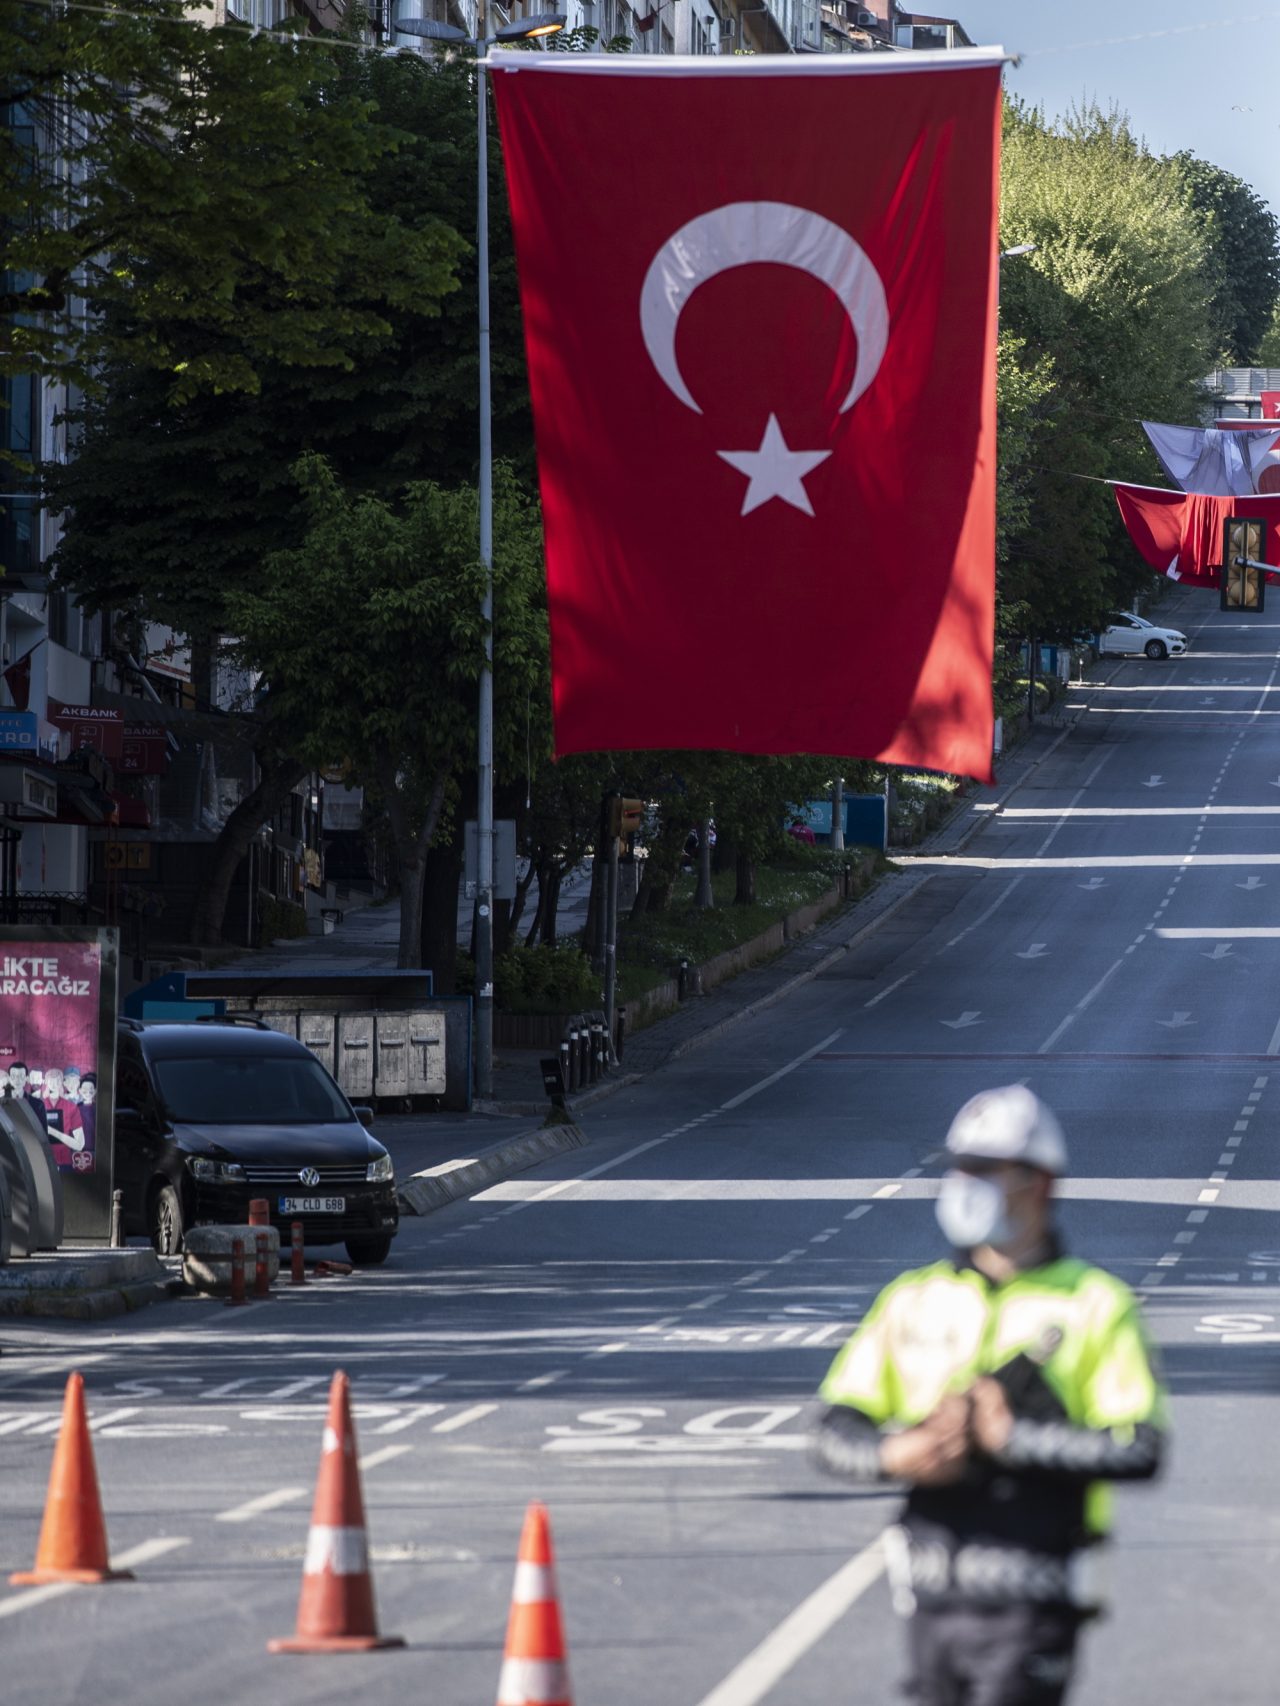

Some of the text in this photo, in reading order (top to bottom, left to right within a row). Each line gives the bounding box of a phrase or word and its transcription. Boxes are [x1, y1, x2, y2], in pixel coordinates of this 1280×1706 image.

[61, 707, 118, 719] AKBANK
[123, 727, 160, 736] BANK
[125, 758, 137, 768] 24
[286, 1199, 297, 1210] 34
[543, 1405, 802, 1436] DS
